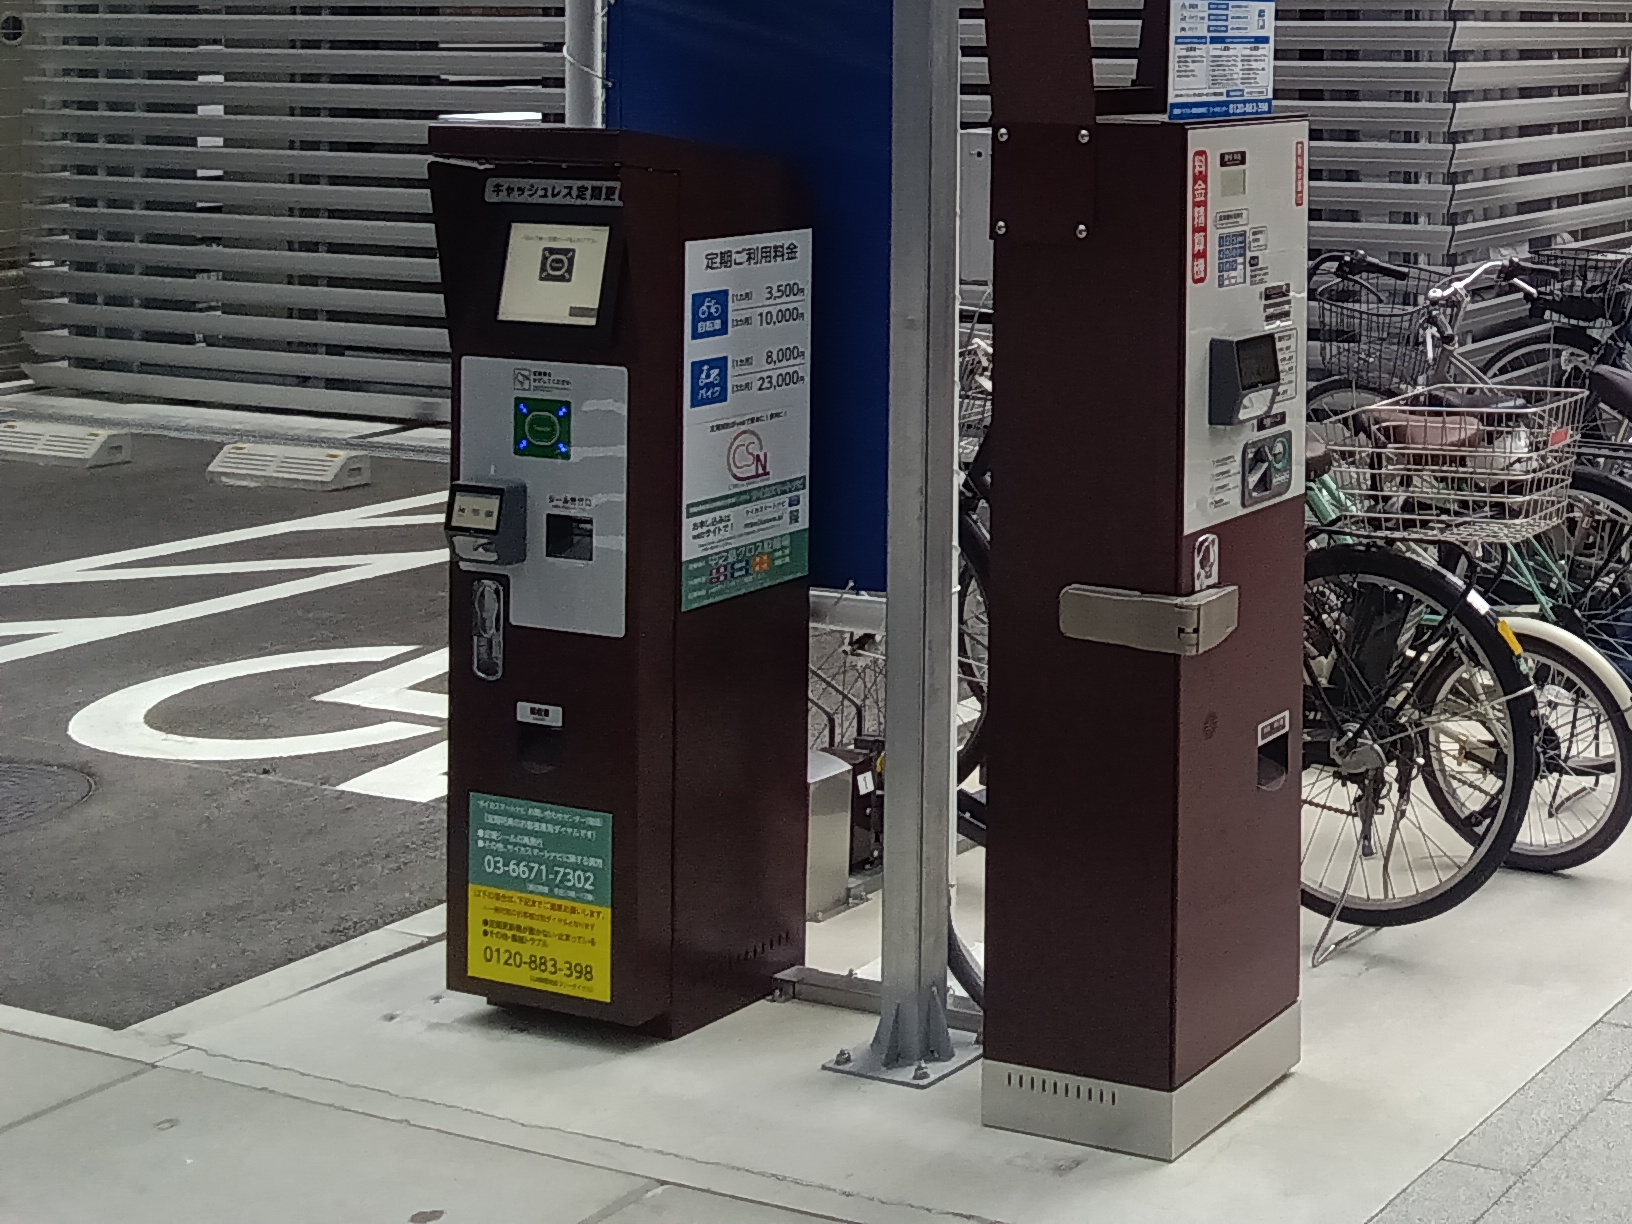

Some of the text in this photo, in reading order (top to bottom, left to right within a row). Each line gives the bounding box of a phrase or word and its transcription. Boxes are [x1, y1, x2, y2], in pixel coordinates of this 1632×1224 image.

[704, 241, 799, 271] 定期ご利用料金
[483, 854, 596, 890] 03-6671-7302
[483, 945, 595, 982] 0120-883-398
